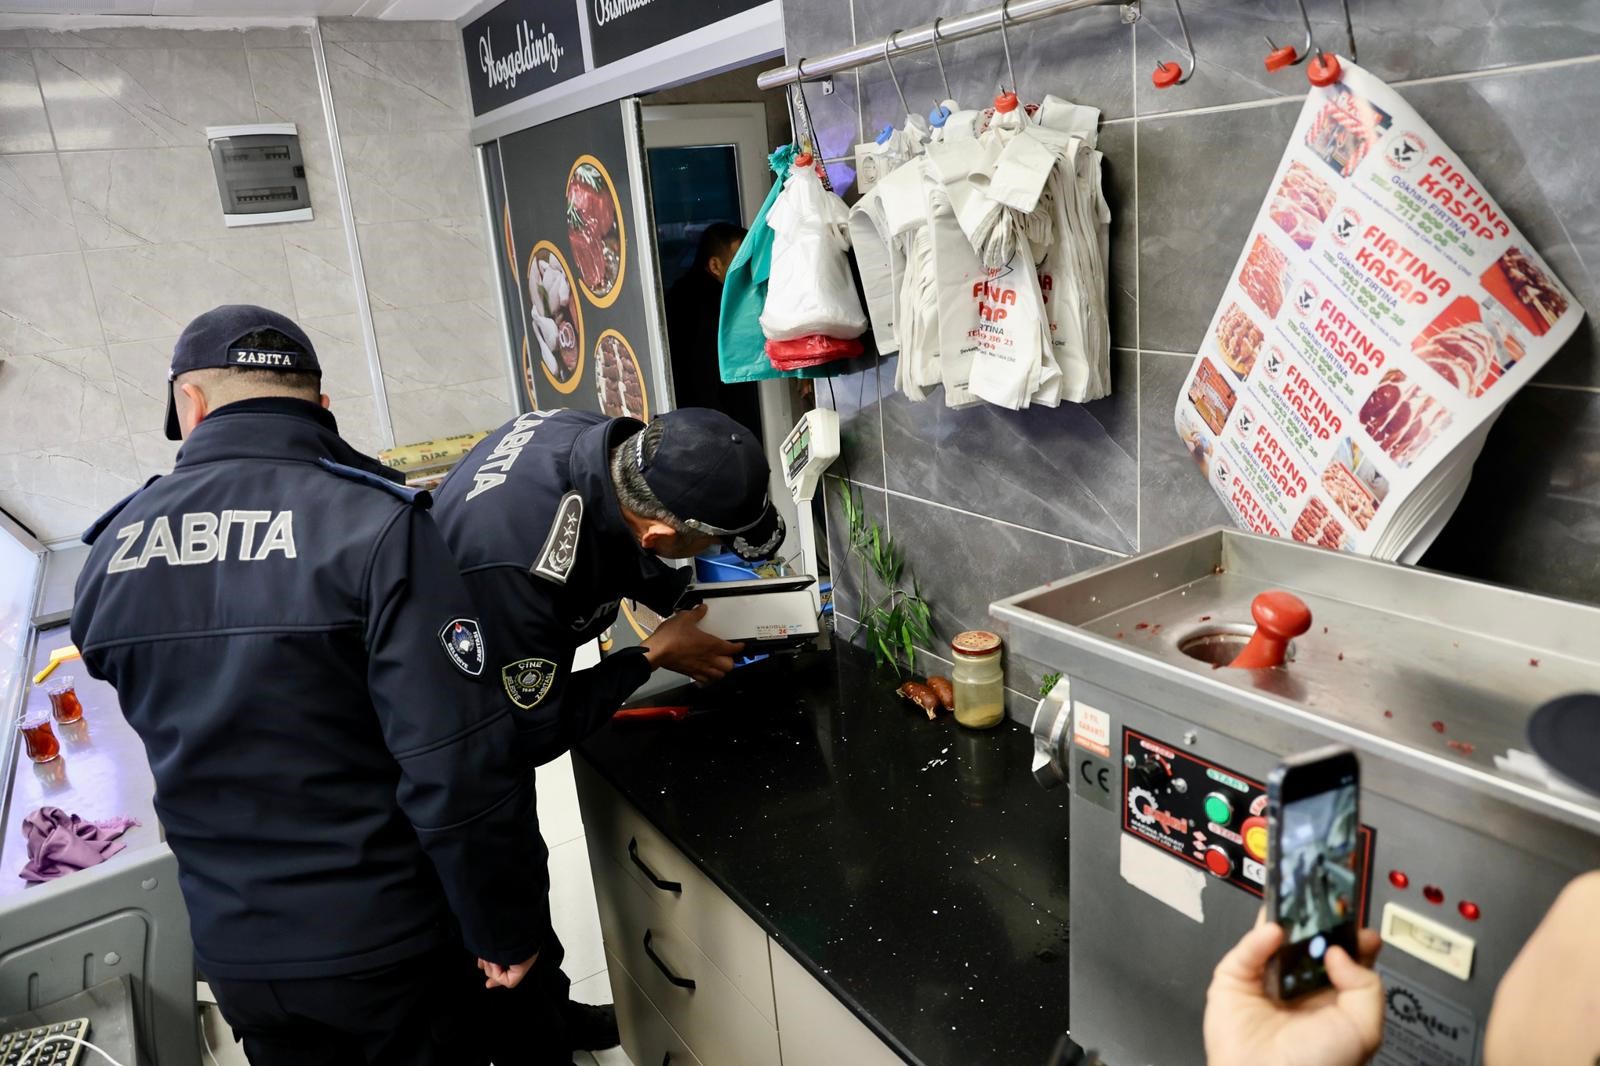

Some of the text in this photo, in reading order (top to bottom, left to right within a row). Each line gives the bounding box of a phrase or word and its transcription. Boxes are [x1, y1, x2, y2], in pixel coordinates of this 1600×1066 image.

[1416, 171, 1494, 238] KASAP
[1427, 153, 1513, 237] FIRTINA
[1428, 203, 1468, 238] FIRTINA
[1354, 246, 1427, 305] KASAP
[1362, 223, 1452, 298] FIRTINA
[1363, 276, 1398, 308] FIRTINA
[237, 352, 292, 366] ZABITA
[1313, 318, 1369, 374] KASAP
[1319, 297, 1388, 369] FIRTINA
[1321, 347, 1349, 377] FIRTINA
[1281, 382, 1331, 439] KASAP
[1285, 364, 1344, 433] FIRTINA
[466, 409, 562, 501] ZABITA
[1251, 441, 1298, 497] KASAP
[1255, 424, 1310, 493] FIRTINA
[1230, 492, 1265, 532] KASA
[107, 510, 297, 574] ZABITA
[1081, 760, 1110, 793] CE
